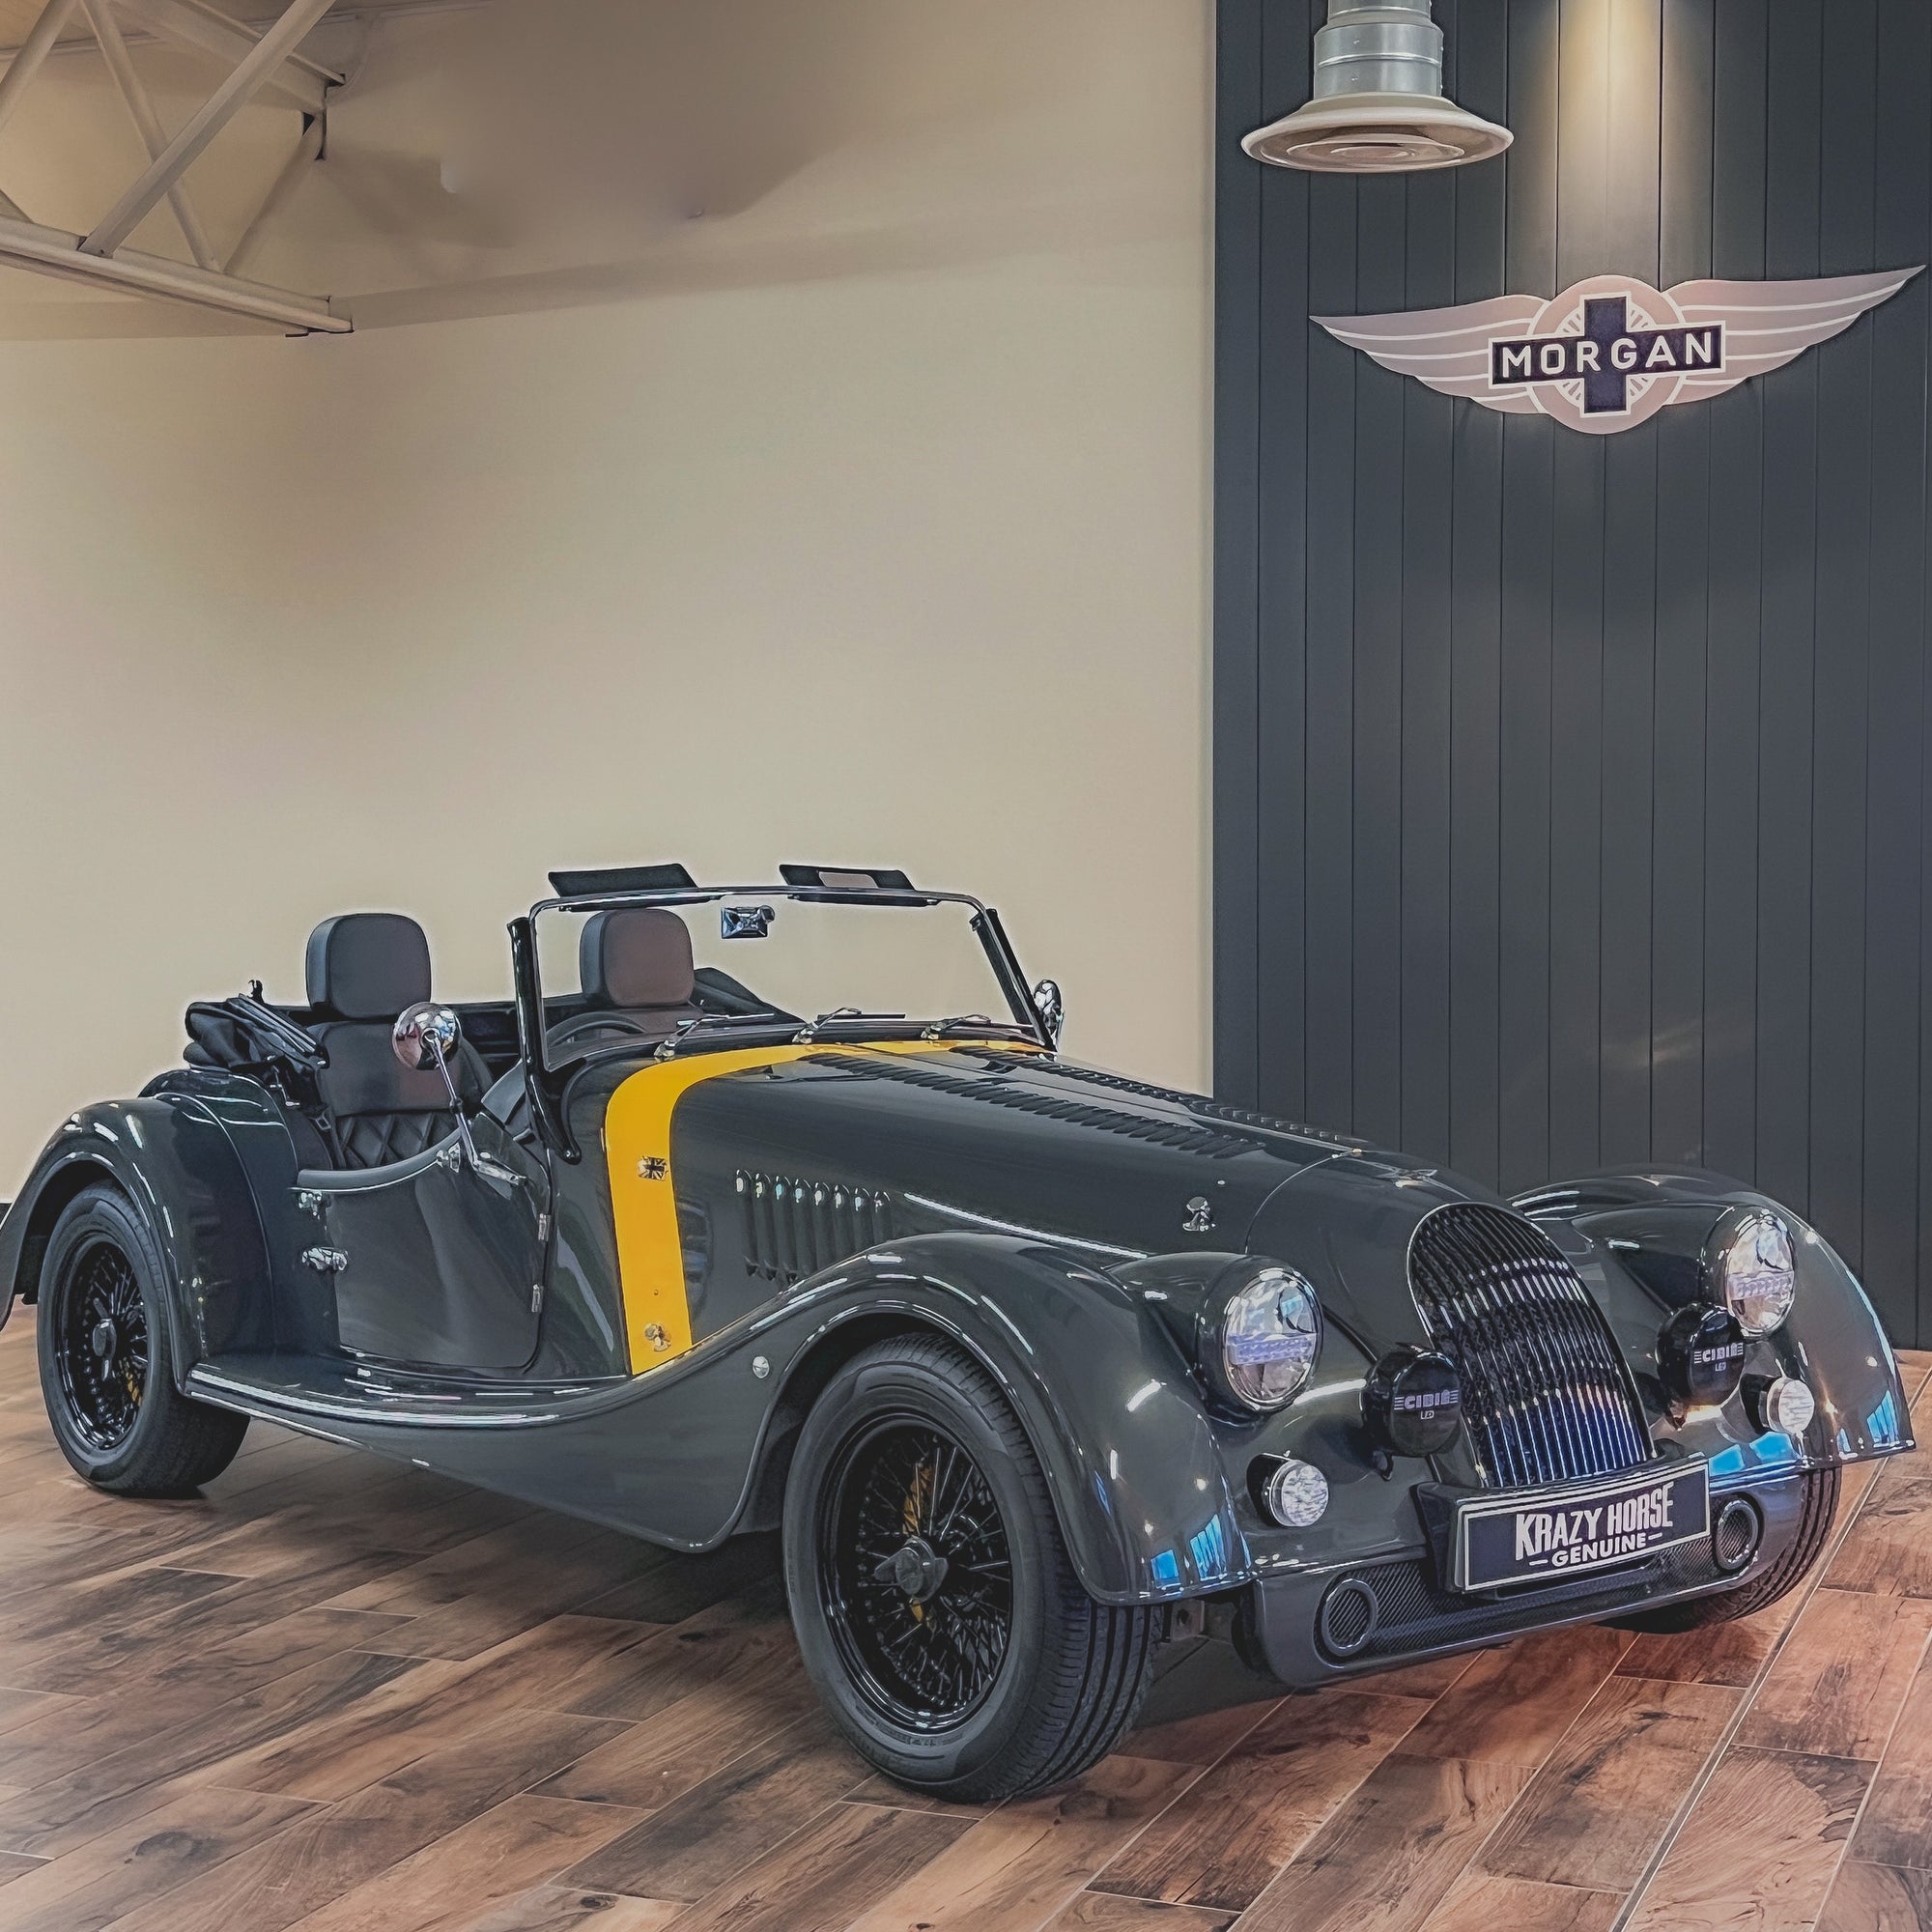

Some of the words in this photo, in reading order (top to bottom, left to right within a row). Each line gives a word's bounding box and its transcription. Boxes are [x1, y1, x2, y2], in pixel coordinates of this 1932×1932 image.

[1502, 331, 1712, 378] MORGAN
[1515, 1507, 1603, 1561] KRAZY
[1606, 1481, 1674, 1535] HORSE
[1551, 1533, 1646, 1567] GENUINE
